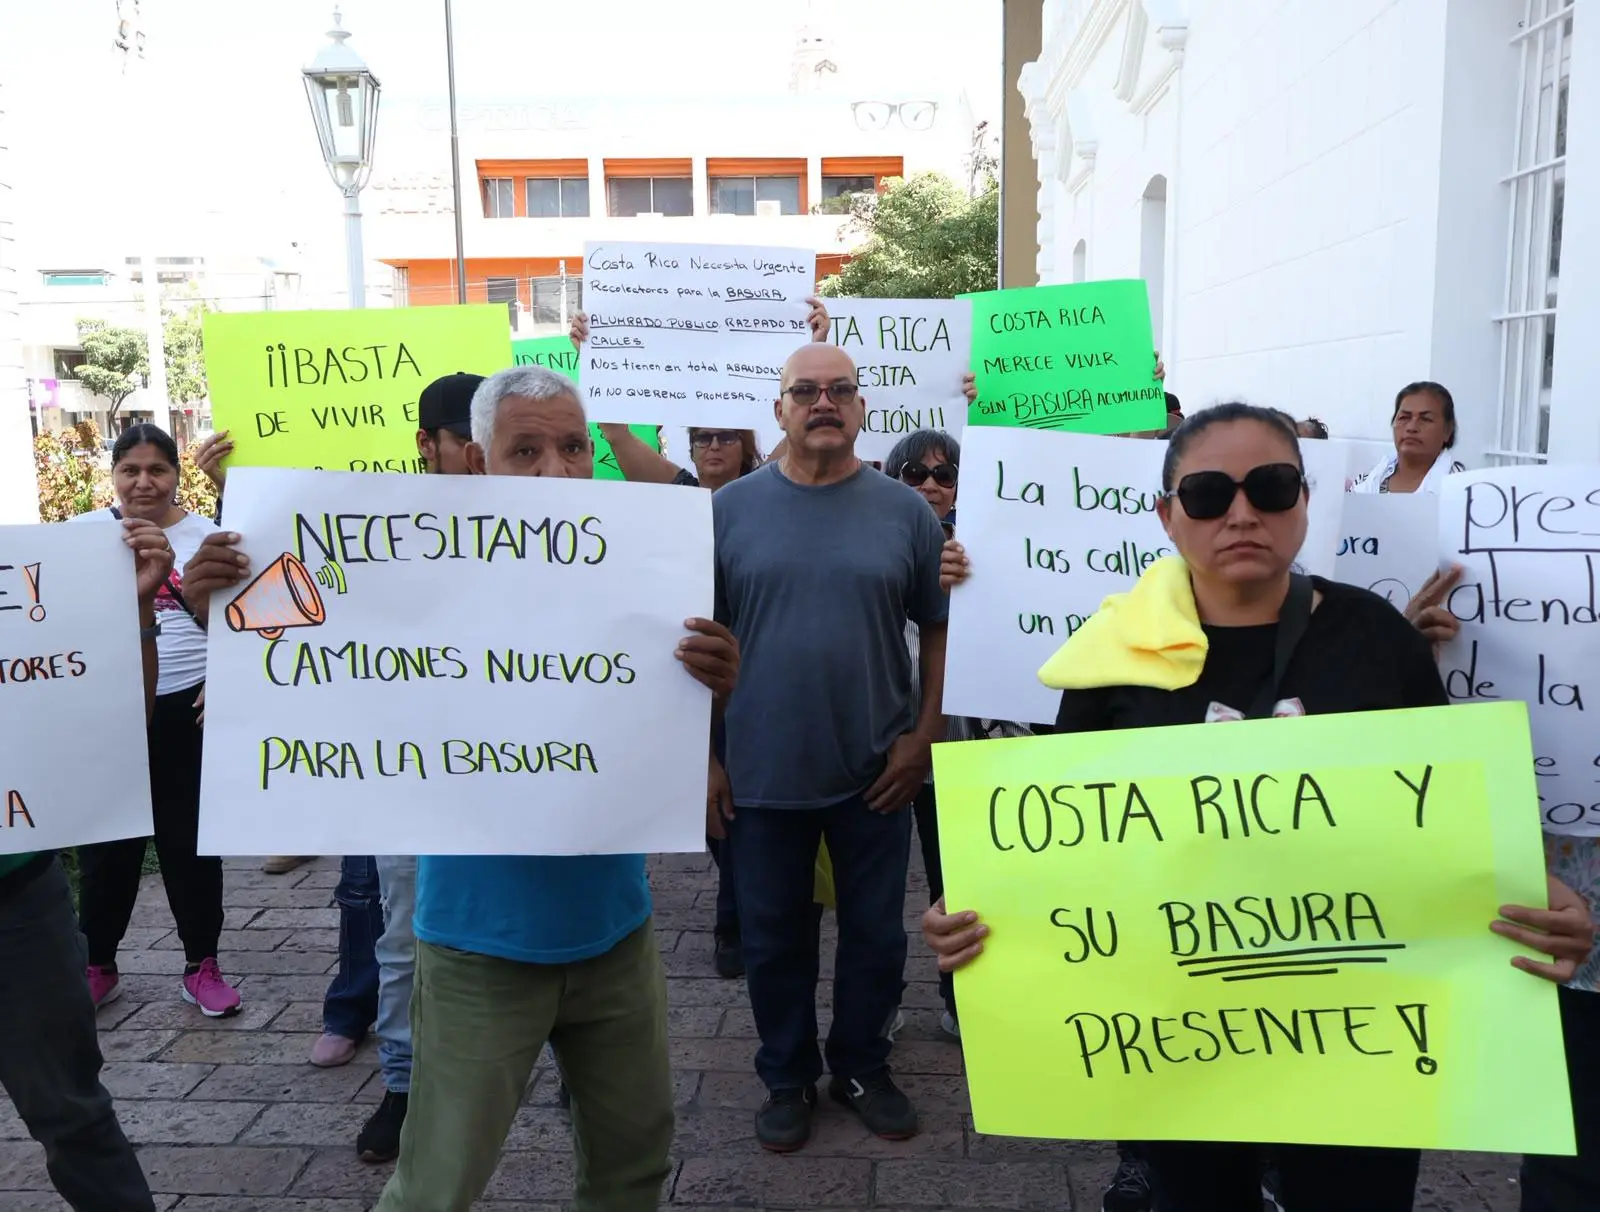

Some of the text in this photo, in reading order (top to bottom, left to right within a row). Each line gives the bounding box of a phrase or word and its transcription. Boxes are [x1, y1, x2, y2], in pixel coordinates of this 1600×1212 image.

[588, 247, 806, 277] Costa Rica Necesita Urgente
[590, 279, 669, 294] Recolectores
[677, 286, 703, 298] para
[707, 287, 721, 298] la
[725, 317, 785, 328] RAZPADO
[790, 319, 806, 329] DE
[828, 315, 951, 352] TA RICA
[990, 305, 1106, 334] COSTA RICA
[515, 351, 580, 370] IDENT
[590, 358, 619, 370] Nos
[622, 358, 661, 371] tienen
[664, 363, 682, 372] en
[687, 360, 719, 372] total
[857, 365, 916, 387] ESITA
[984, 351, 1118, 375] MERECE VIVIR
[588, 385, 601, 398] YA
[606, 387, 622, 397] NO
[978, 387, 1163, 420] SIN BASURA ACUMULADA
[256, 401, 419, 438] DE VIVIR E
[996, 460, 1163, 515] La basu
[294, 511, 608, 566] NECESITAMOS
[1025, 537, 1070, 574] las
[1447, 551, 1600, 626] atend
[1017, 613, 1092, 637] un p
[263, 639, 637, 687] CAMIONES NUEVOS
[1446, 639, 1583, 712] de la
[260, 736, 599, 791] PARA LA BASURA
[0, 789, 36, 829] A
[988, 763, 1434, 854] COSTA RICA Y
[1050, 891, 1387, 964] SU BASURA
[1064, 1002, 1438, 1079] PRESENTE!
